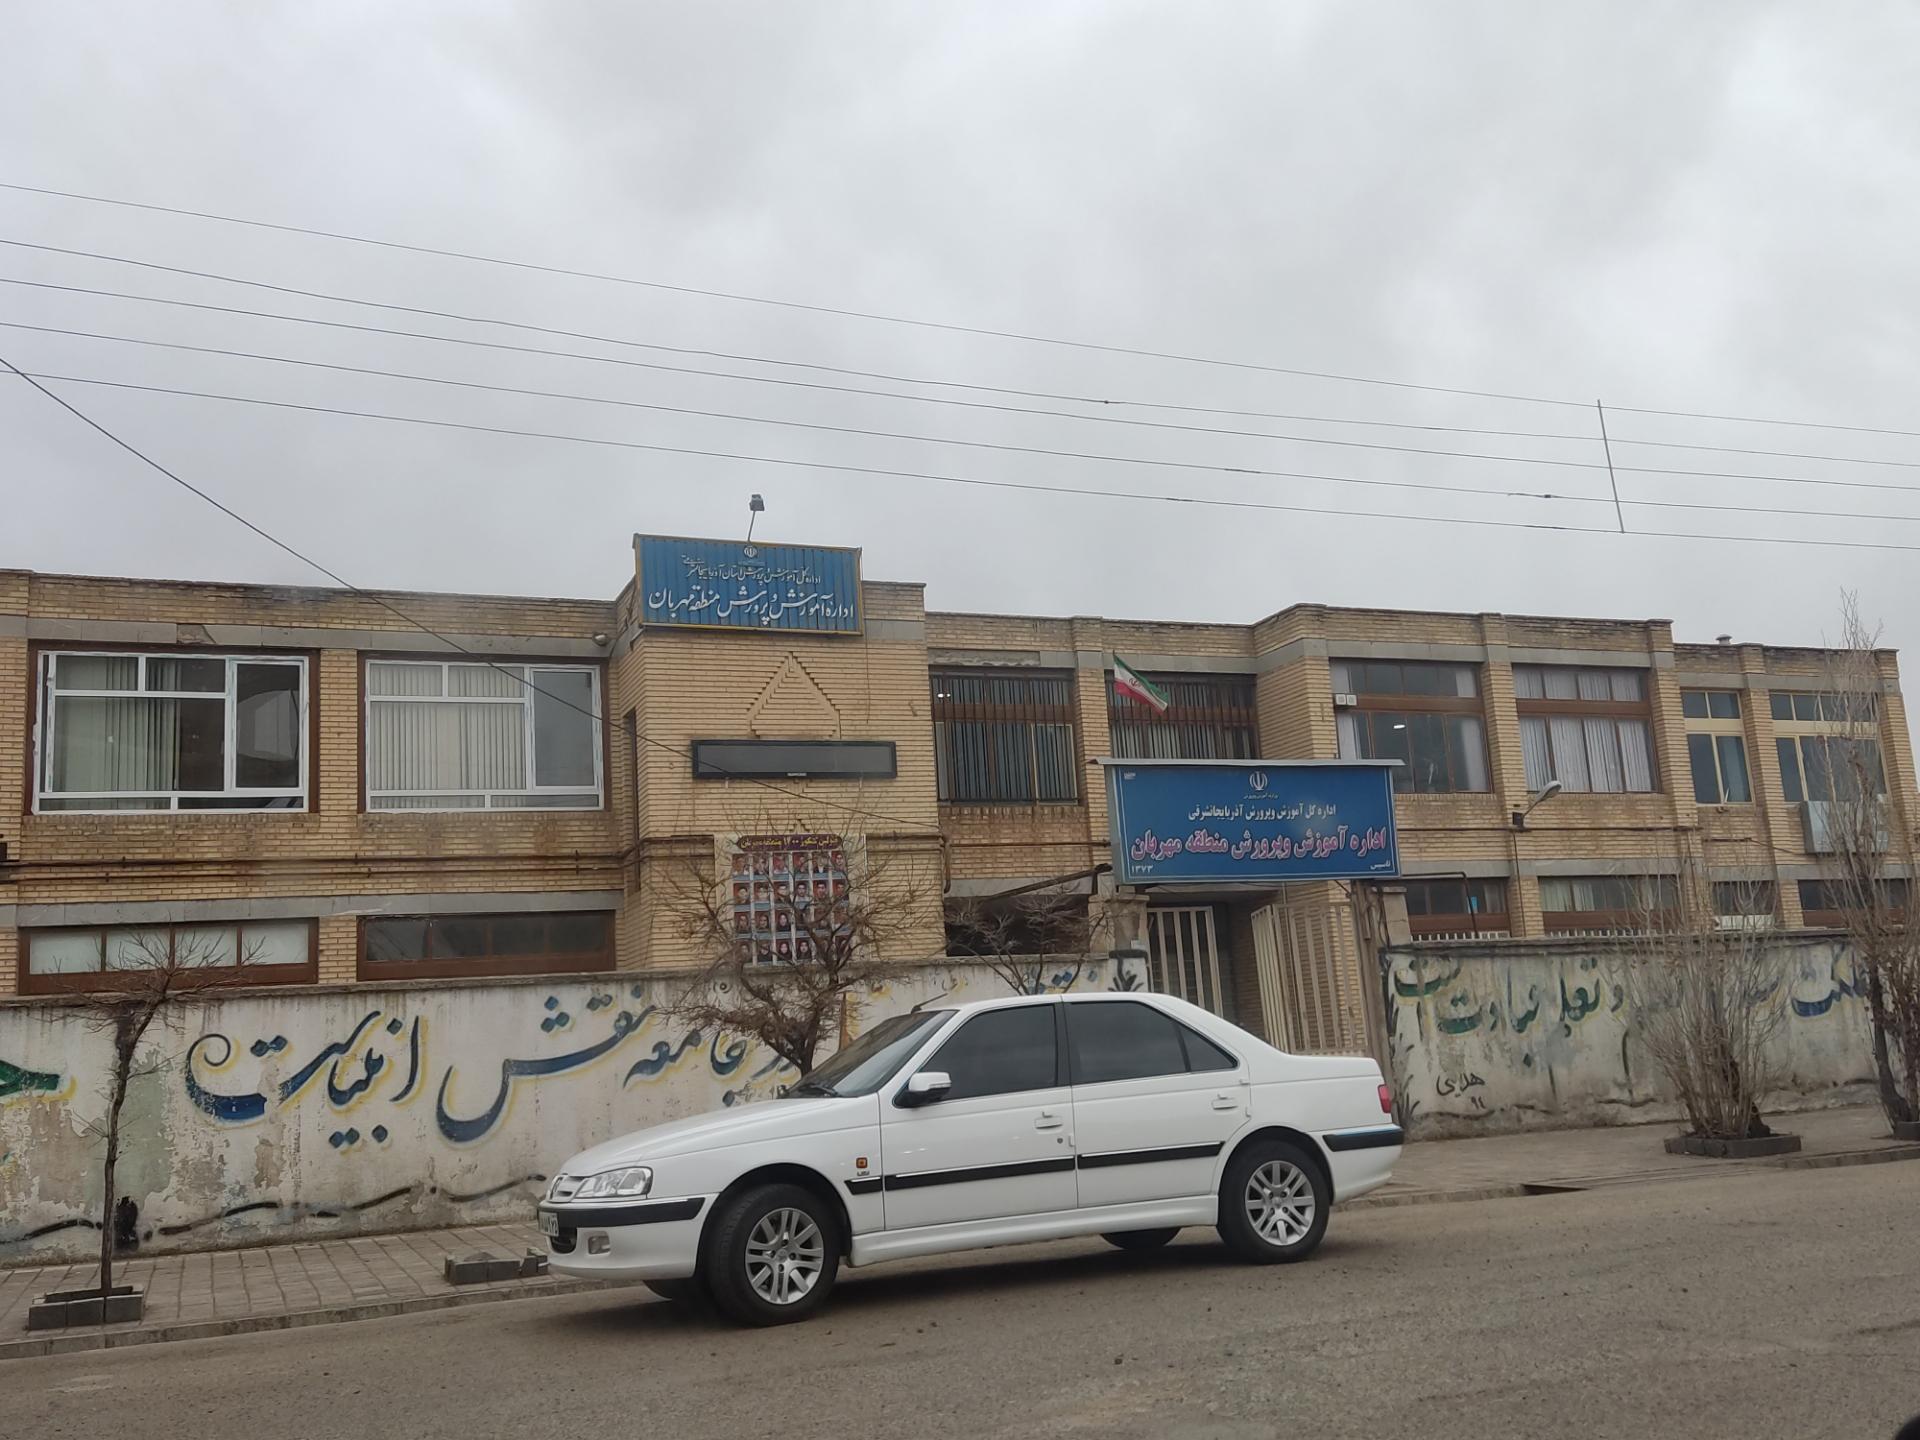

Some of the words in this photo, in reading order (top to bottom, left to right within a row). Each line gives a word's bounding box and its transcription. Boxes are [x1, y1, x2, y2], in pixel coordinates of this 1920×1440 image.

[648, 586, 695, 618] مهربان
[688, 585, 720, 611] منطقه
[717, 585, 768, 626] پرورش
[769, 588, 834, 620] آموزش
[1277, 802, 1304, 819] آموزش
[1305, 804, 1317, 819] کل
[1317, 804, 1337, 819] اداره
[1131, 829, 1183, 861] مهربان
[1185, 828, 1229, 853] منطقه
[1293, 825, 1349, 858] آموزش
[1350, 826, 1387, 857] اداره
[436, 984, 656, 1142] نقش
